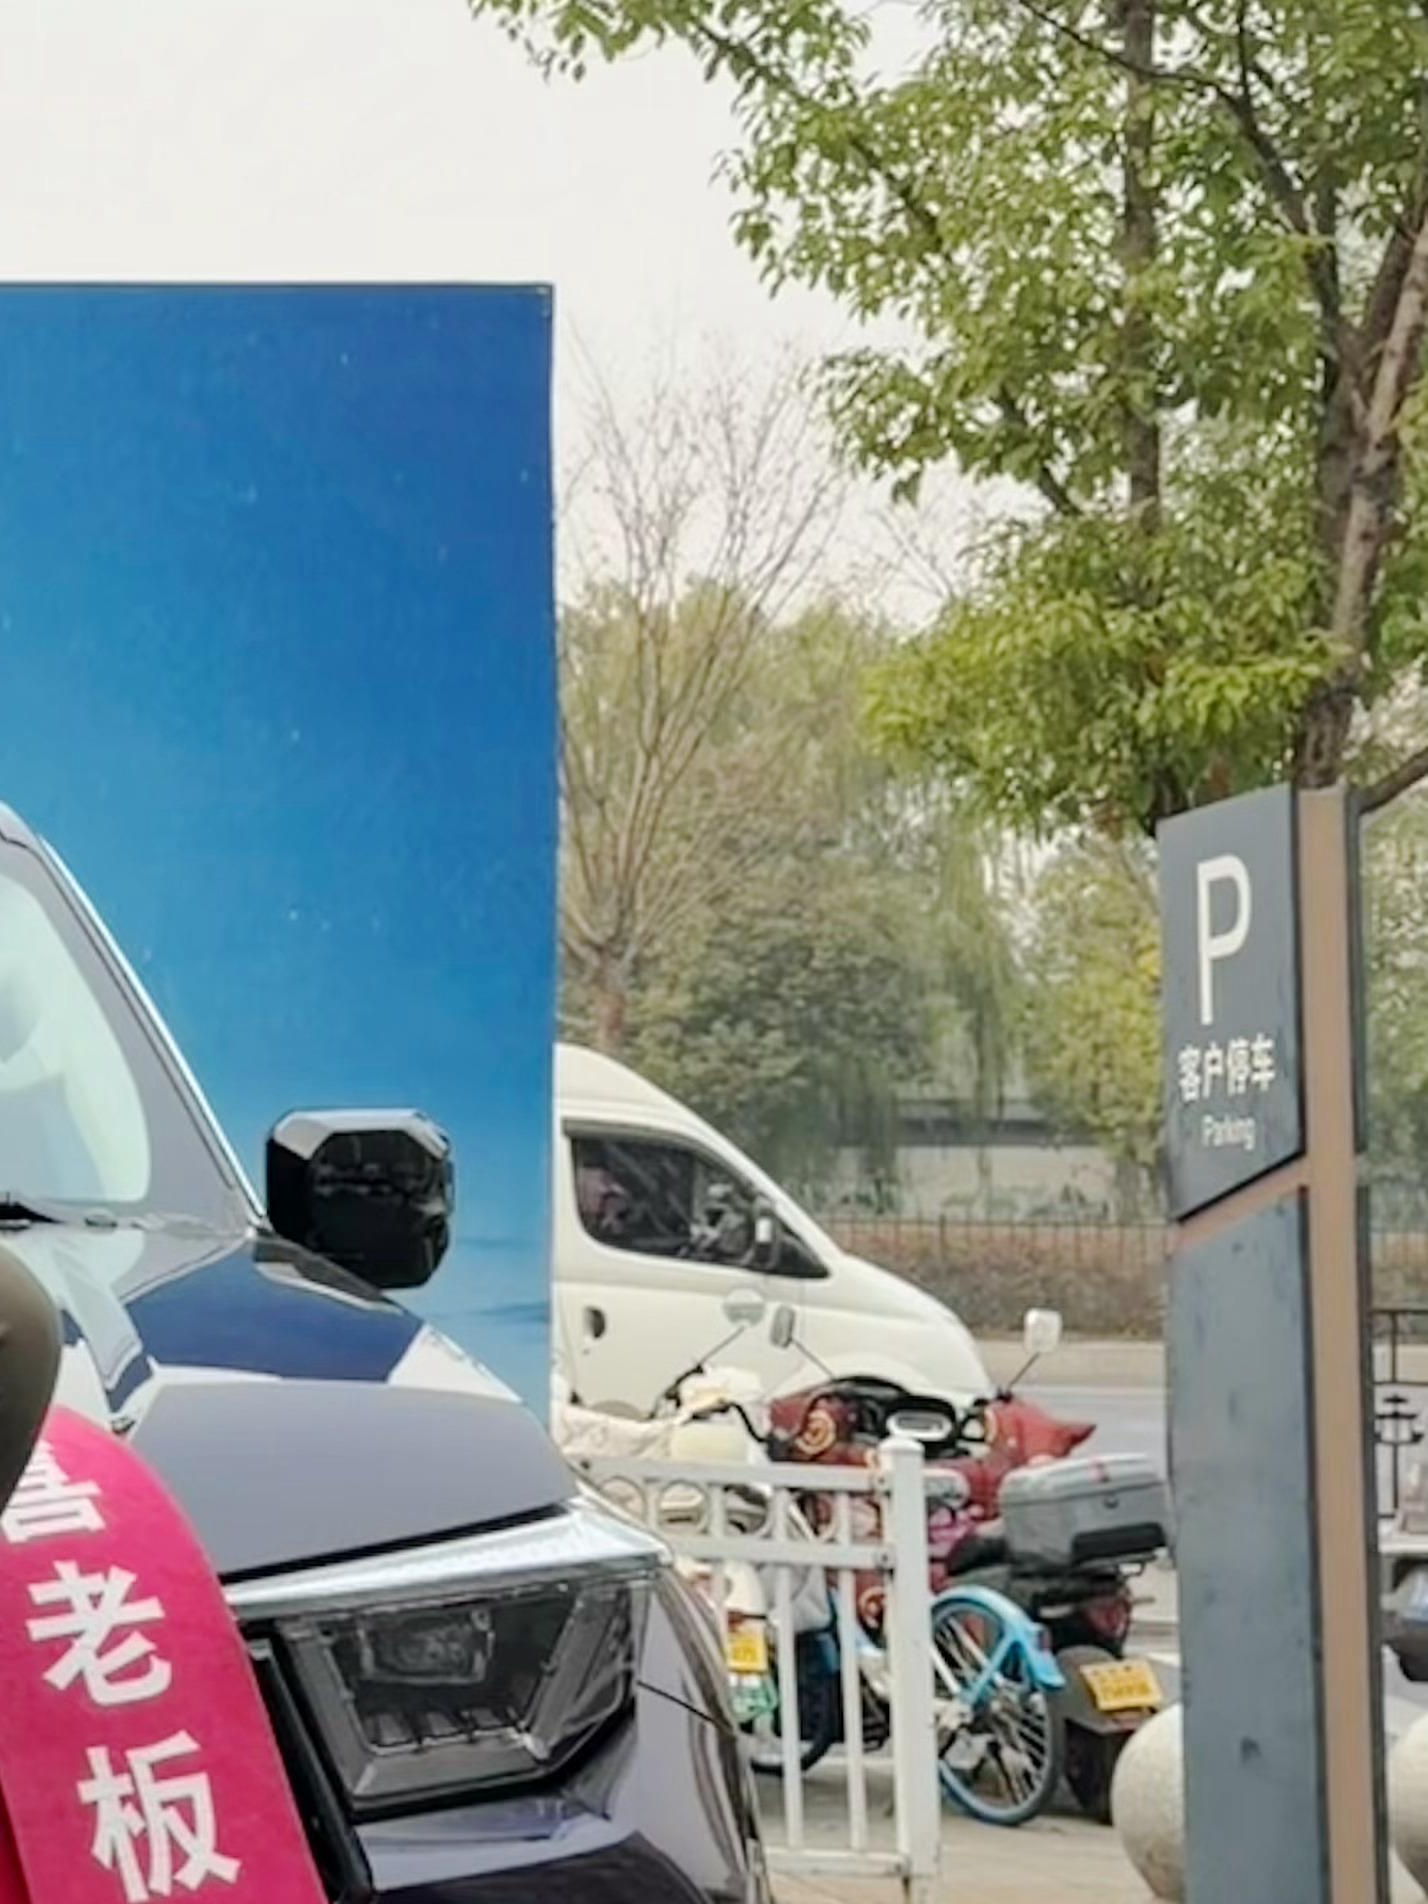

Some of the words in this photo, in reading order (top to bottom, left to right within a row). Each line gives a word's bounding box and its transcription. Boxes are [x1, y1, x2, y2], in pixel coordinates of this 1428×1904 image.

[1197, 853, 1252, 1025] P
[1178, 1032, 1275, 1102] 客户停车
[1202, 1115, 1256, 1150] Parking
